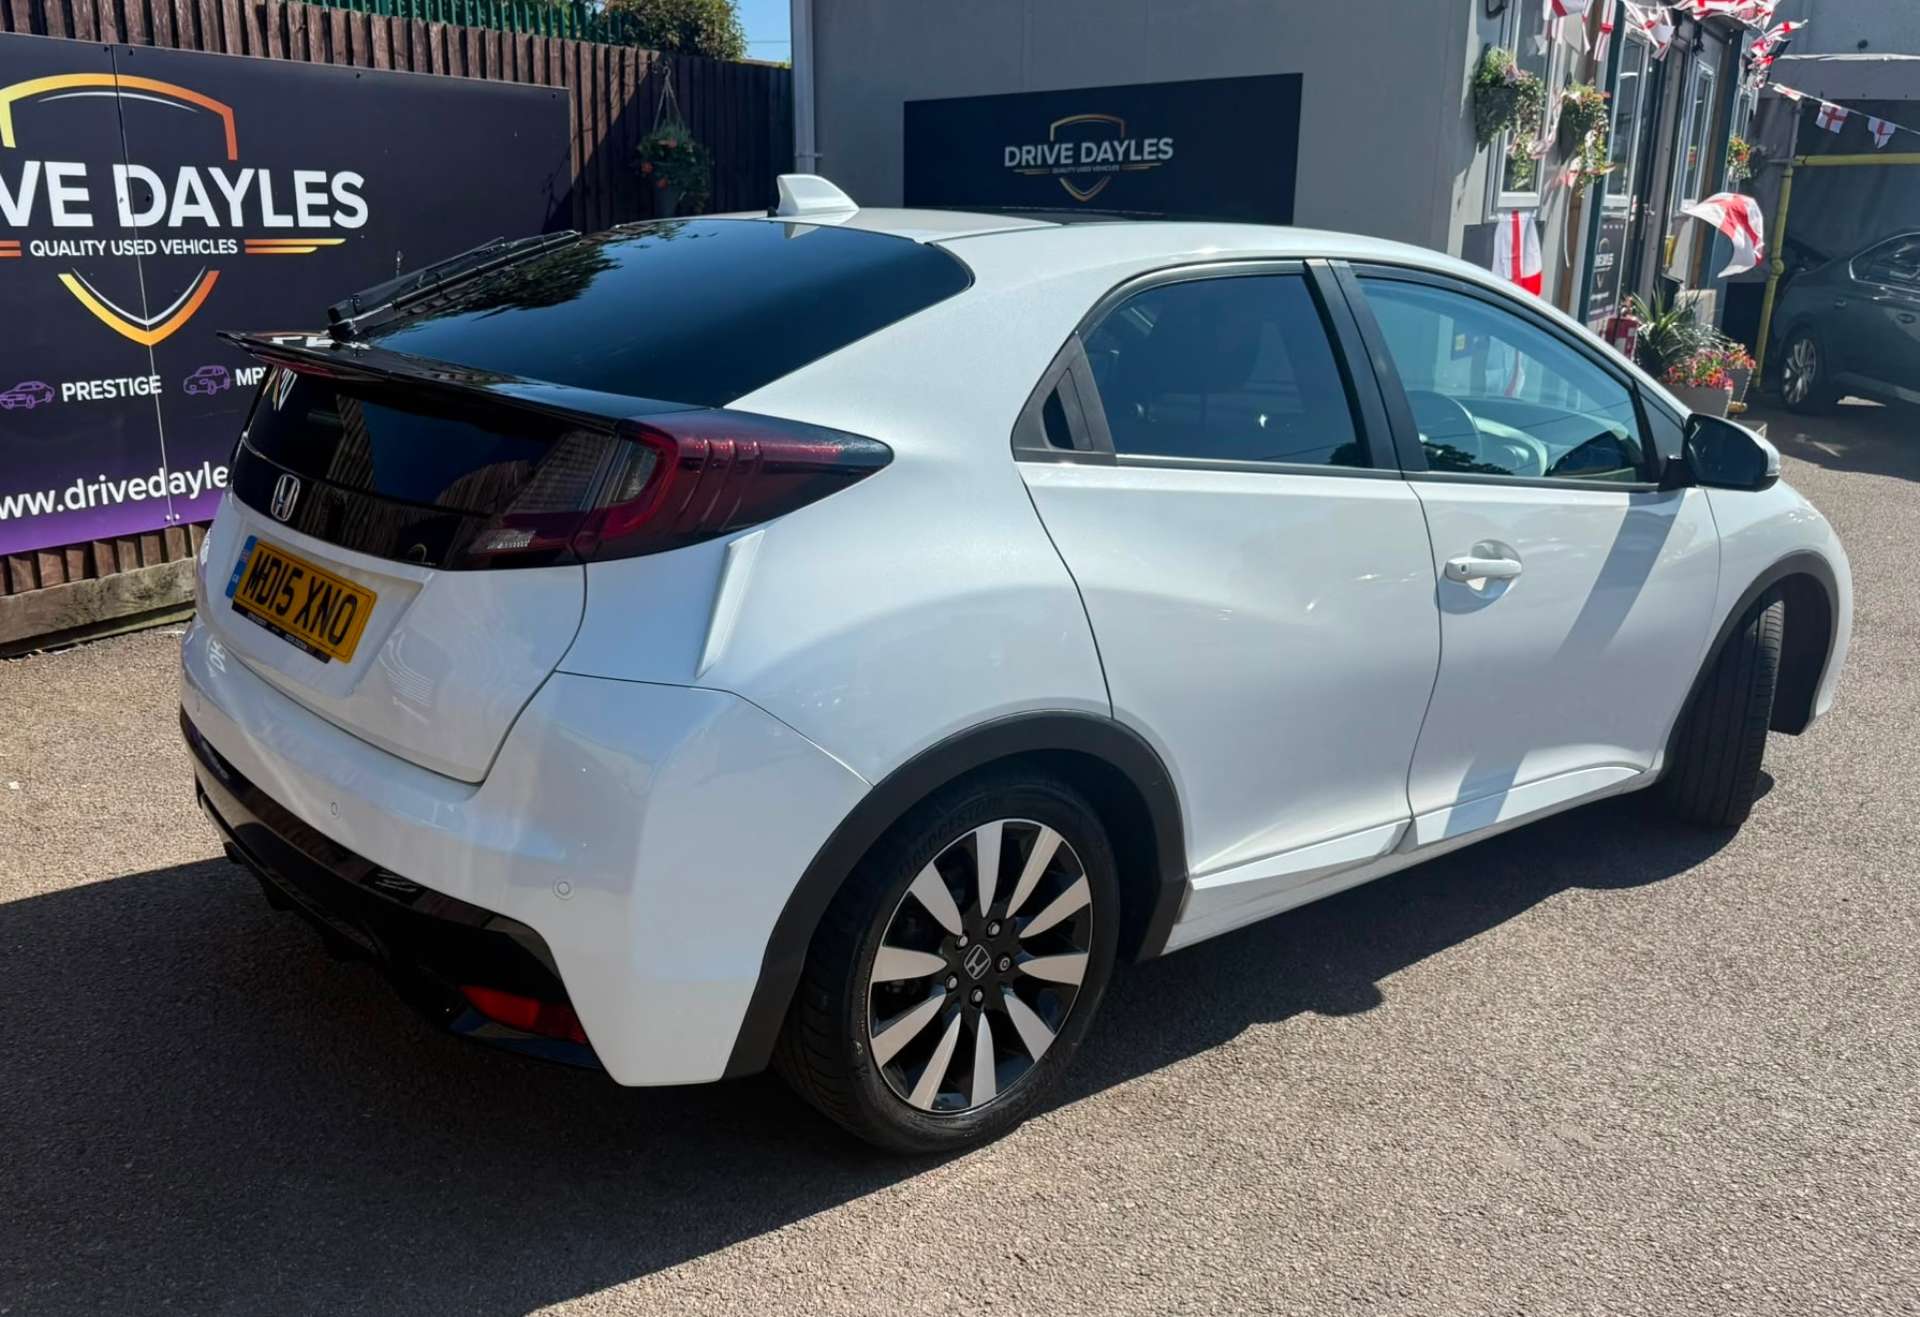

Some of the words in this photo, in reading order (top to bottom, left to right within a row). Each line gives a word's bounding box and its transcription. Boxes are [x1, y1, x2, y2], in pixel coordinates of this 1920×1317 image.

[1004, 143, 1074, 167] DRIVE
[1080, 137, 1174, 163] DAYLES
[0, 160, 94, 228] VE
[112, 163, 369, 229] DAYLES
[30, 240, 107, 257] QUALITY
[111, 240, 156, 256] USED
[160, 239, 238, 254] VEHICLES
[61, 375, 162, 402] PRESTIGE
[235, 366, 267, 387] MP
[243, 550, 304, 617] MD15
[294, 575, 358, 646] XNO
